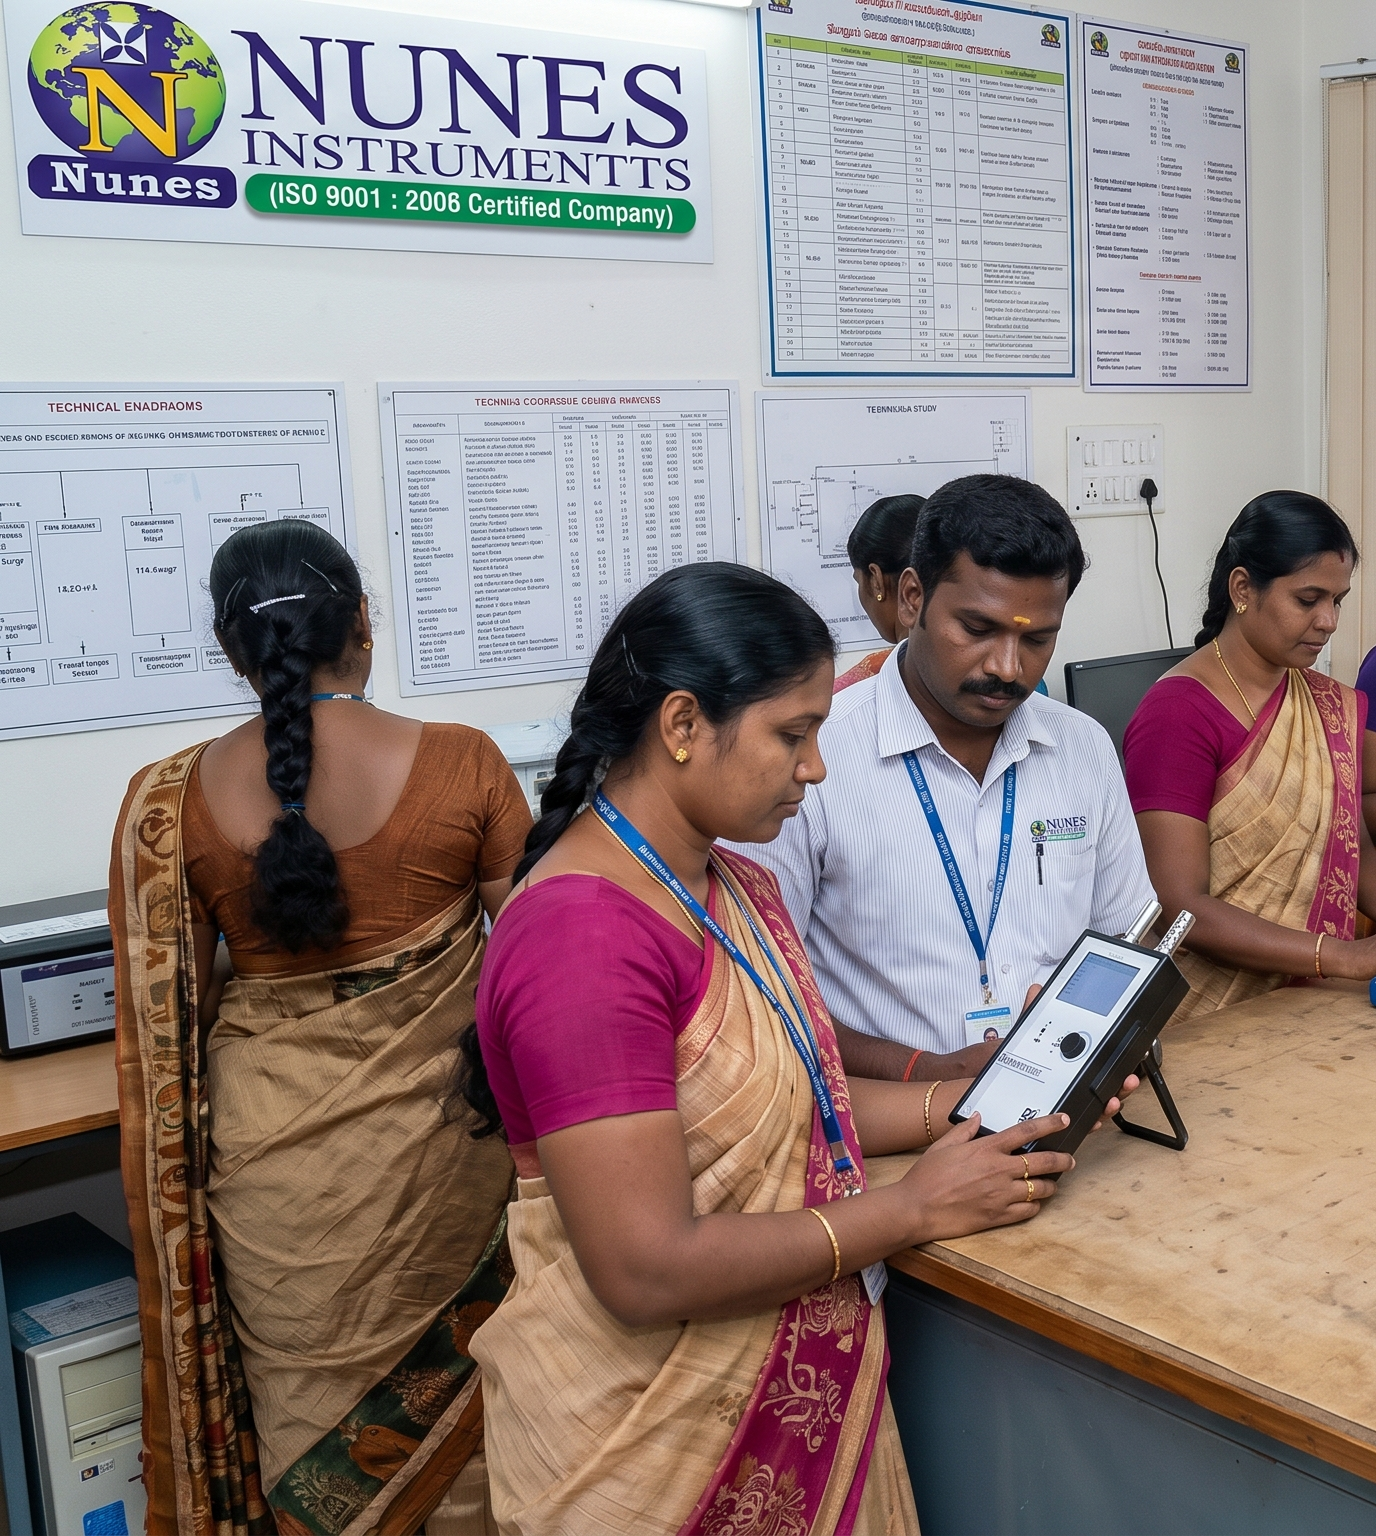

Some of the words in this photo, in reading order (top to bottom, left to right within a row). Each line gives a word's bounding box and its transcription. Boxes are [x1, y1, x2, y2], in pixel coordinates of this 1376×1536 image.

[231, 29, 689, 149] NUNES
[240, 129, 692, 191] INSTRUMENTTS
[50, 162, 221, 201] Nunes
[269, 184, 318, 207] (ISO
[326, 186, 382, 210] 9001
[405, 189, 461, 213] 2006
[468, 194, 561, 220] Certified
[567, 199, 674, 229] Company)
[48, 402, 120, 413] TECHNICAL
[1046, 816, 1086, 829] NUNES
